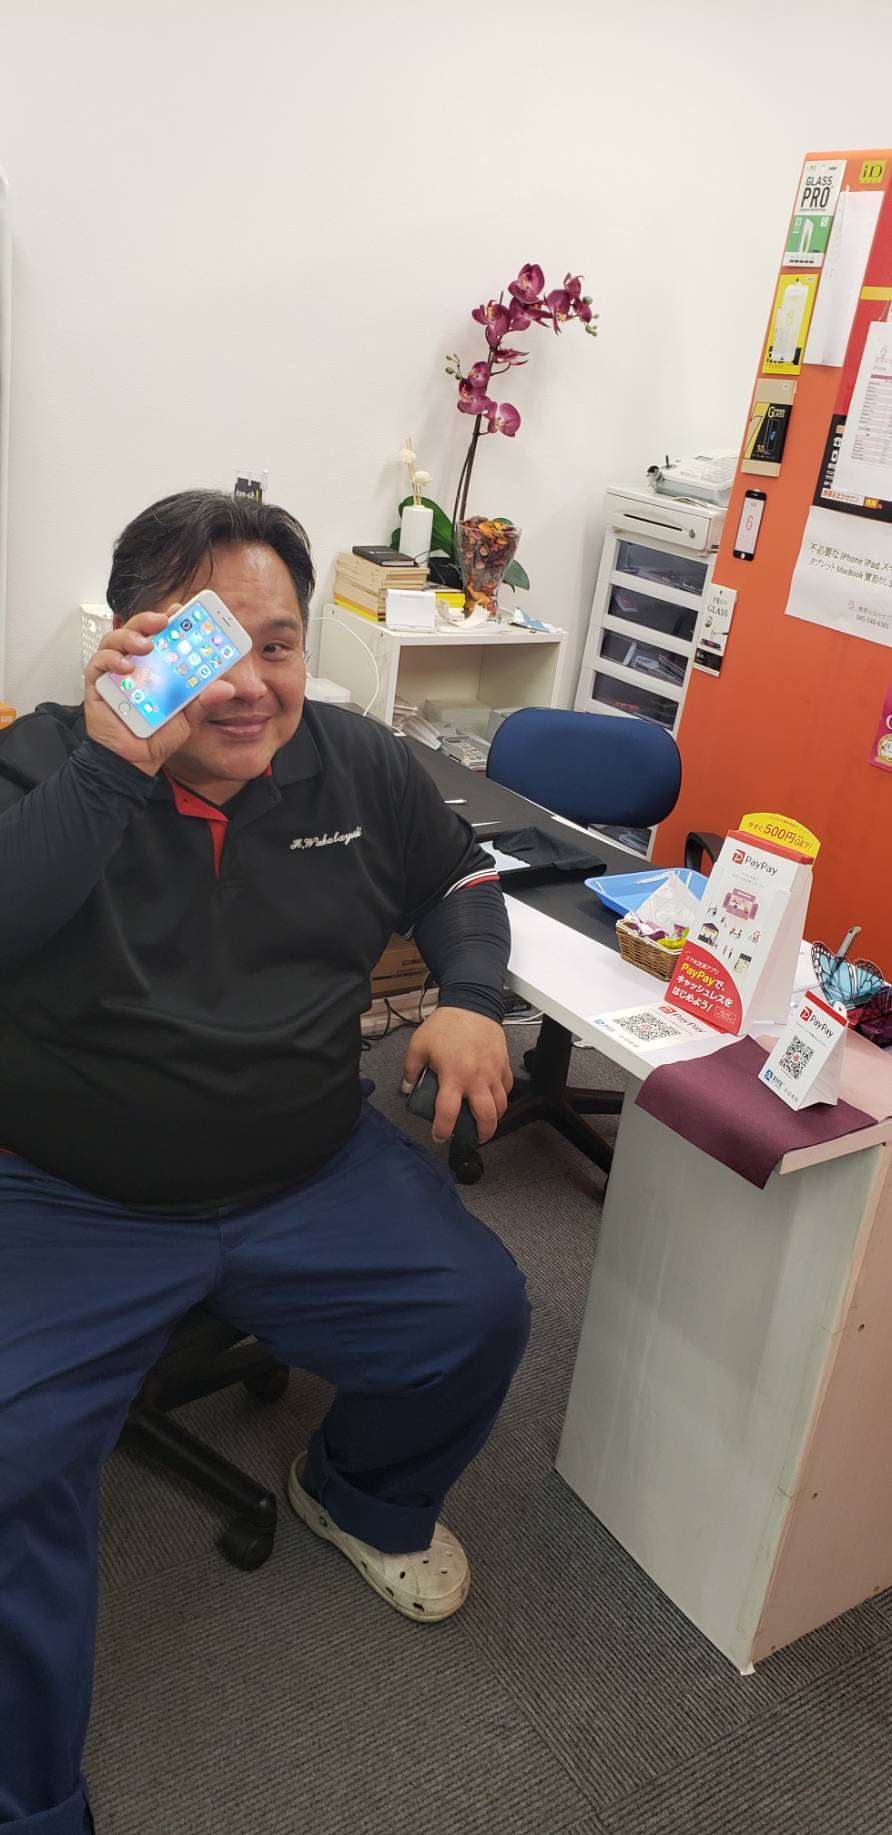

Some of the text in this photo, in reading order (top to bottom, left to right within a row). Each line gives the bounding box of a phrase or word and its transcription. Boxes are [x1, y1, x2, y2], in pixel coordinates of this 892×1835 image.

[806, 176, 833, 186] GLASS
[840, 551, 863, 566] iPhone
[865, 558, 880, 570] iPad
[836, 565, 863, 579] MacBook
[707, 605, 729, 618] GLASS
[744, 855, 778, 876] PayPay
[676, 975, 734, 1008] キャッシュレスを
[673, 1013, 705, 1033] PayPay
[810, 1015, 835, 1038] PayPay
